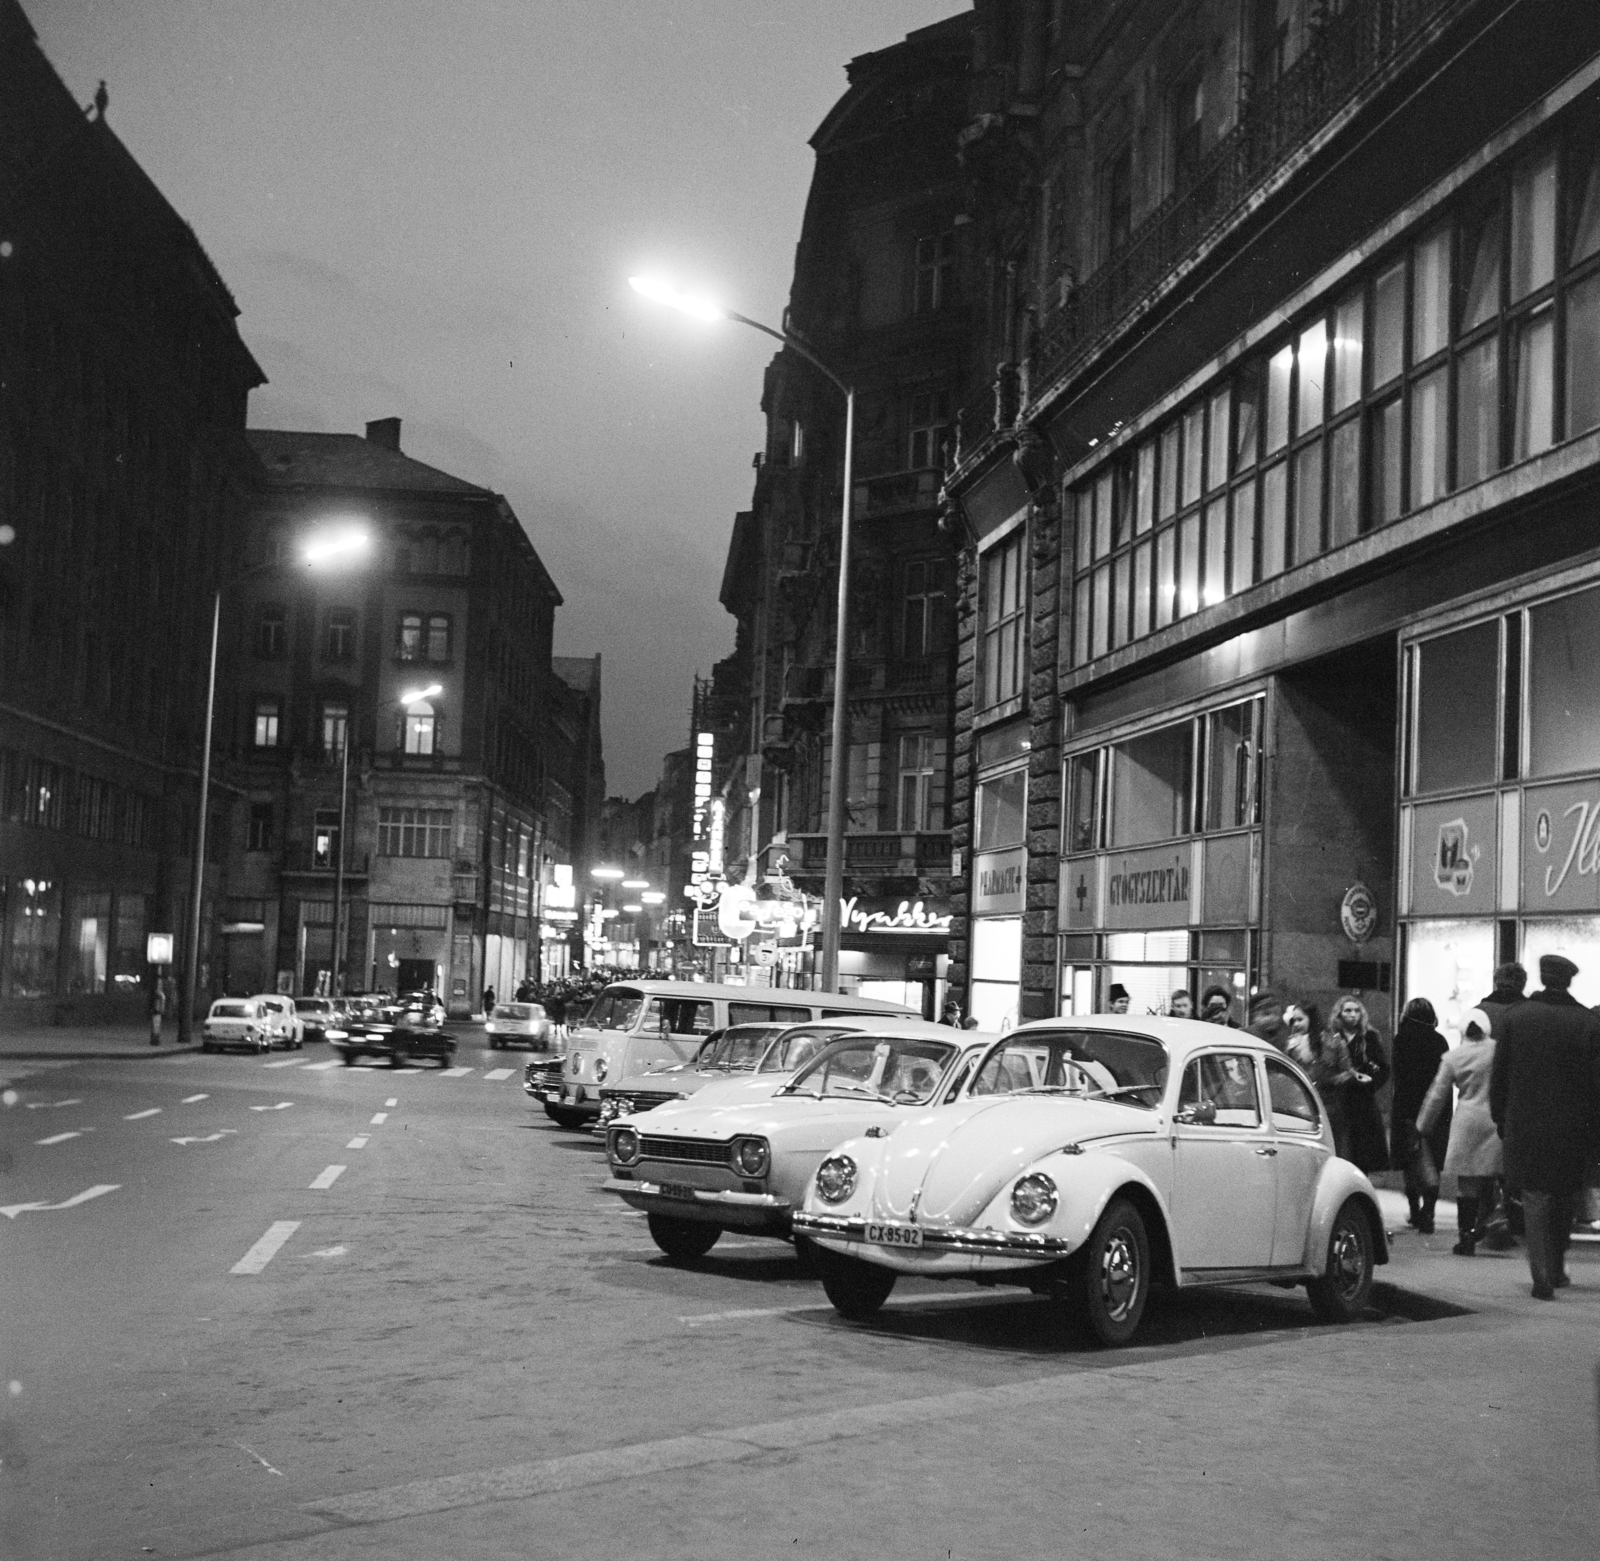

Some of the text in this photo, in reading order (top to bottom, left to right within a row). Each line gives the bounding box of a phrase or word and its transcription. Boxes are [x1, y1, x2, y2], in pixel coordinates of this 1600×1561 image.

[979, 866, 1016, 896] PHARMACIE
[1109, 855, 1189, 905] GYÓGYSZERTÁR
[152, 937, 168, 960] P
